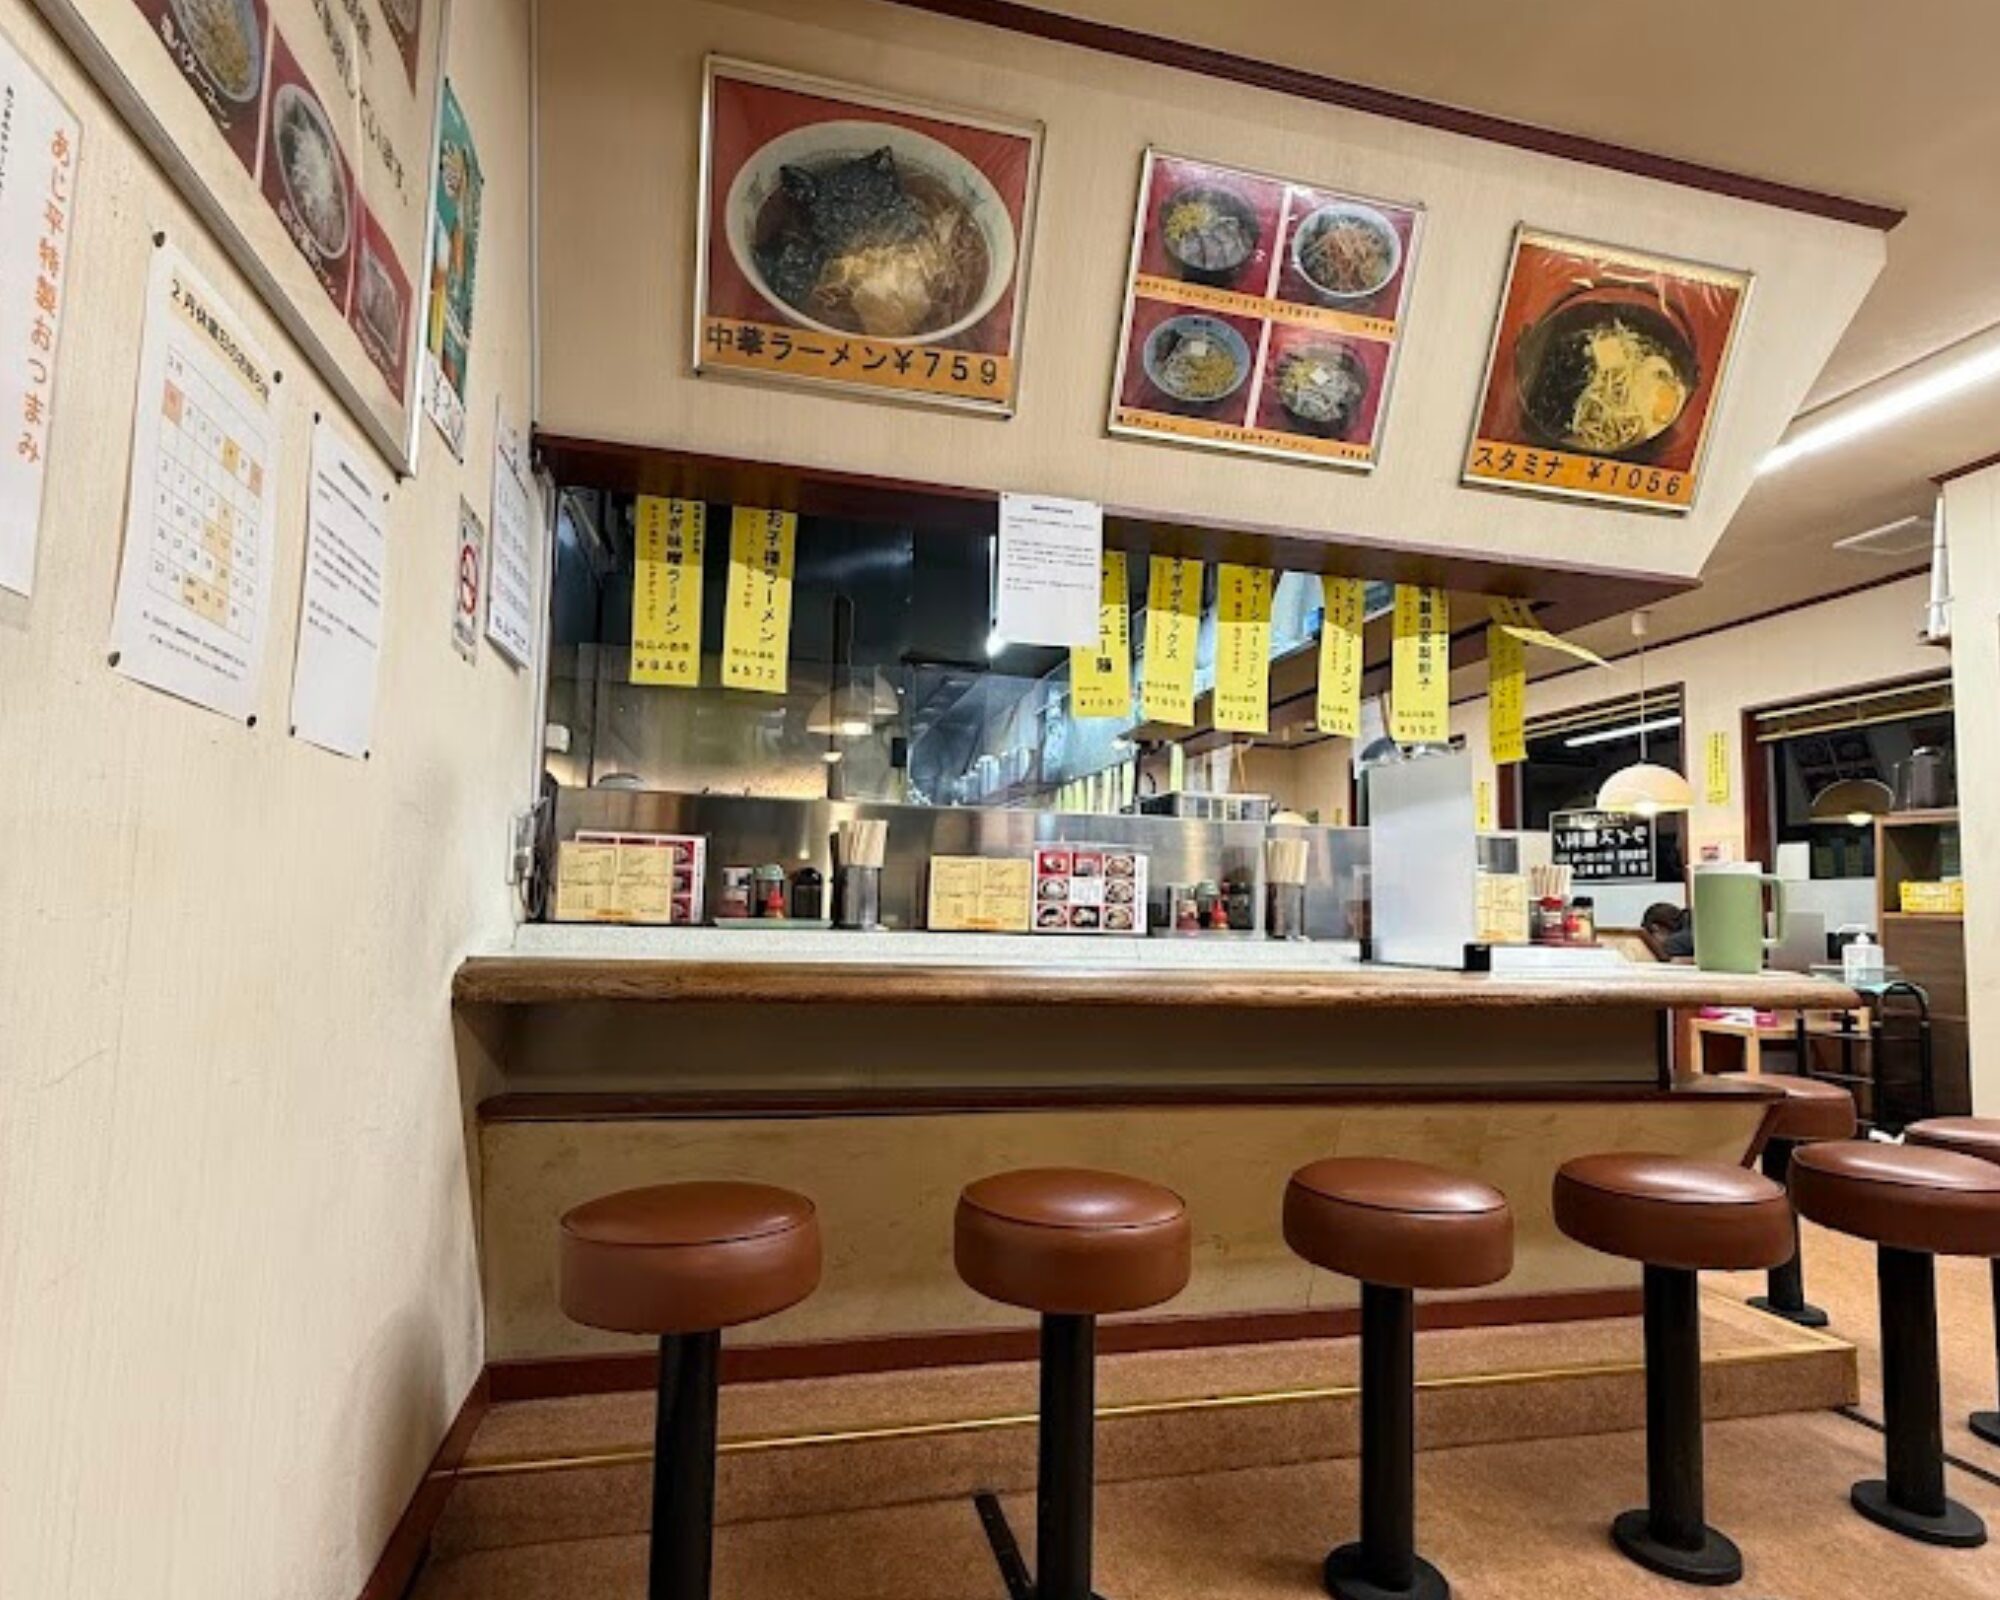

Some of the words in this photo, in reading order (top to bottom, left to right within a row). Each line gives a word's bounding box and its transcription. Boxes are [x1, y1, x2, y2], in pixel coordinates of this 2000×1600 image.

[1474, 446, 1564, 479] スタミナ
[1587, 459, 1682, 497] ¥1056
[760, 507, 784, 643] お子様ラーメン
